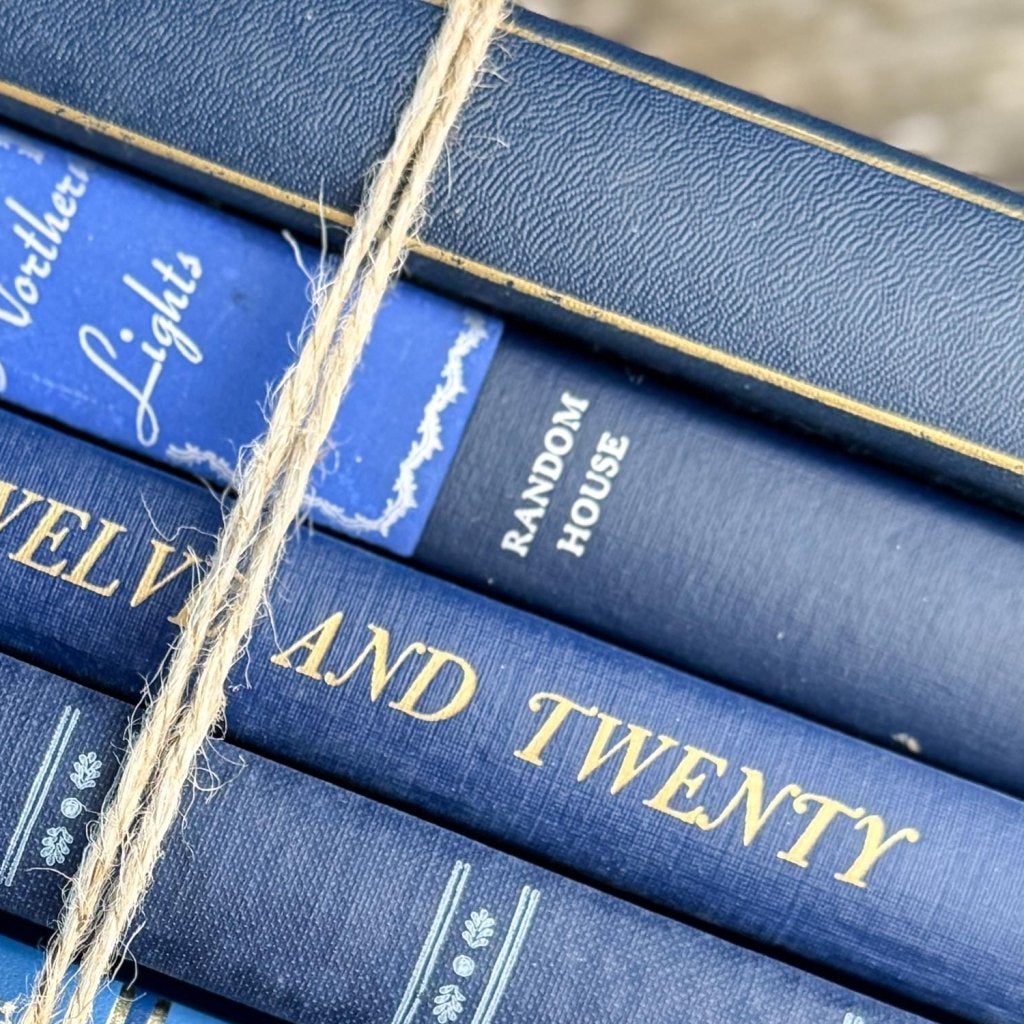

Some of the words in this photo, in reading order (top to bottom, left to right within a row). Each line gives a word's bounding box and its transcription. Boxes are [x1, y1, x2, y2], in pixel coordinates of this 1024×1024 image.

[78, 250, 203, 446] Lights
[501, 392, 590, 557] RANDOM
[556, 432, 629, 557] HOUSE
[270, 611, 478, 722] AND
[513, 692, 920, 889] TWENTY
